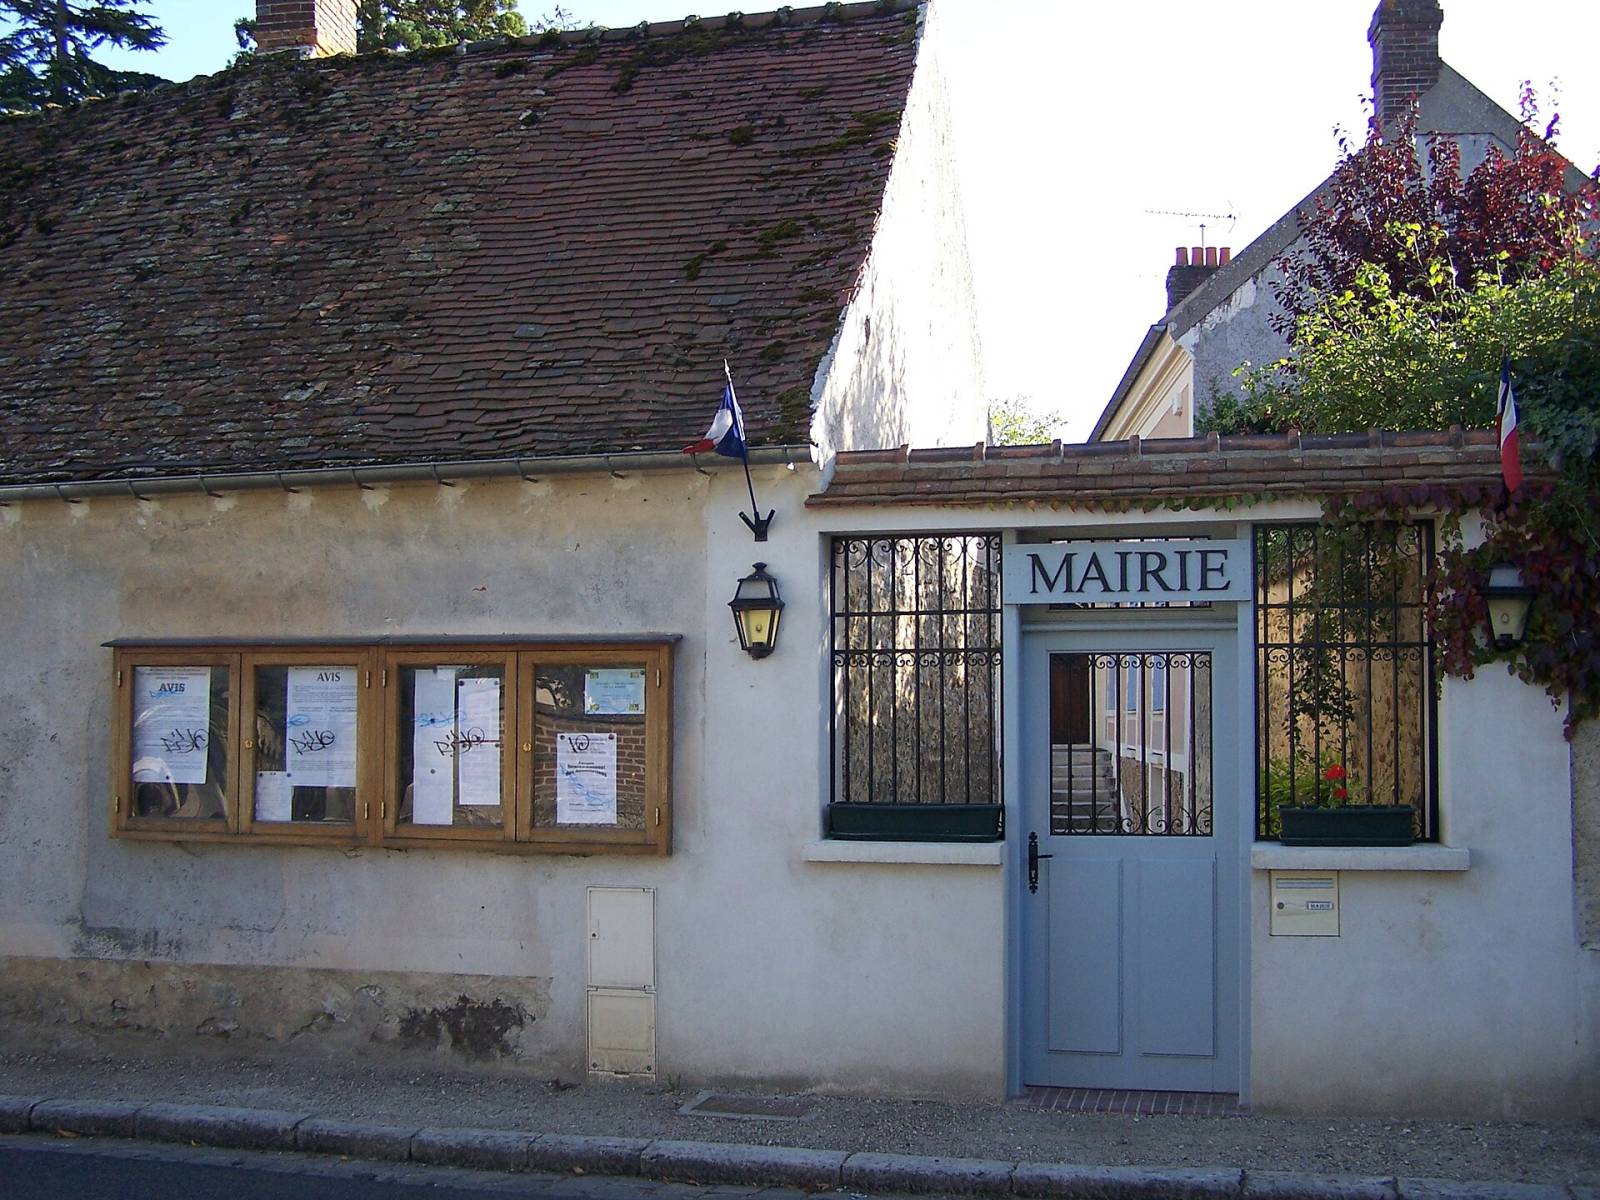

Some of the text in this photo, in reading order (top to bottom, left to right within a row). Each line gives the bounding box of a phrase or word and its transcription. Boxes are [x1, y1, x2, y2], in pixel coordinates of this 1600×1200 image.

[1026, 549, 1231, 594] MAIRIE
[317, 672, 341, 682] AVIS
[159, 682, 186, 692] AVIS
